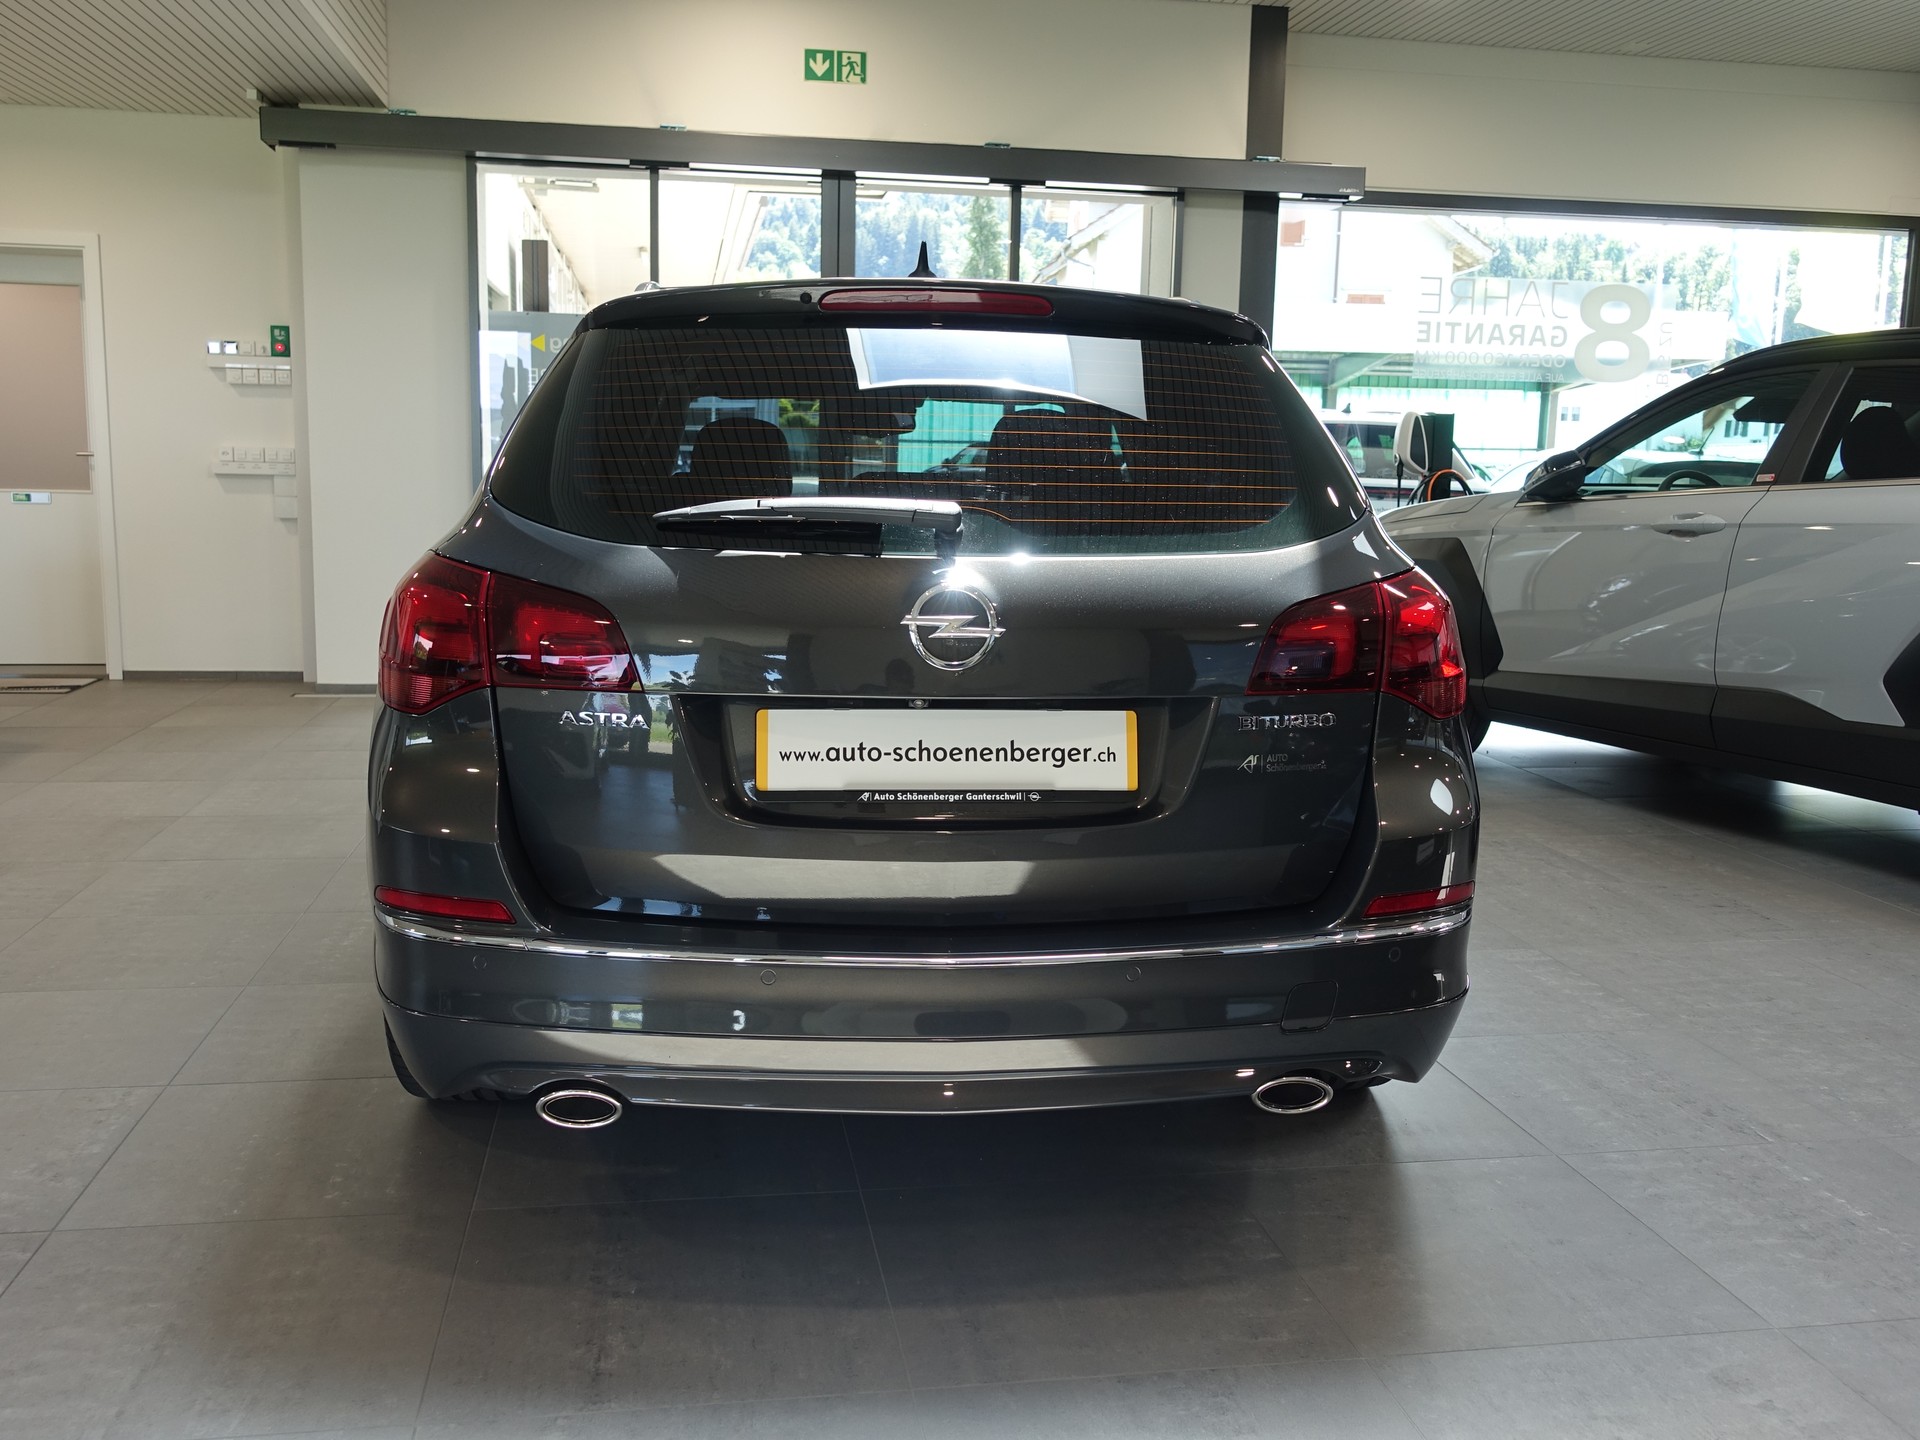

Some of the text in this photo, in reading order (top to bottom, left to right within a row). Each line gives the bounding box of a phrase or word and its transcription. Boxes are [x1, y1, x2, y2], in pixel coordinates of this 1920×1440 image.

[559, 710, 650, 730] ASTRA
[779, 740, 1117, 768] www.auto-schoenenberger.ch
[1266, 753, 1289, 763] AUTO
[873, 792, 895, 801] Auto
[897, 791, 963, 803] Schönenberger
[965, 791, 1022, 801] Ganterschwil
